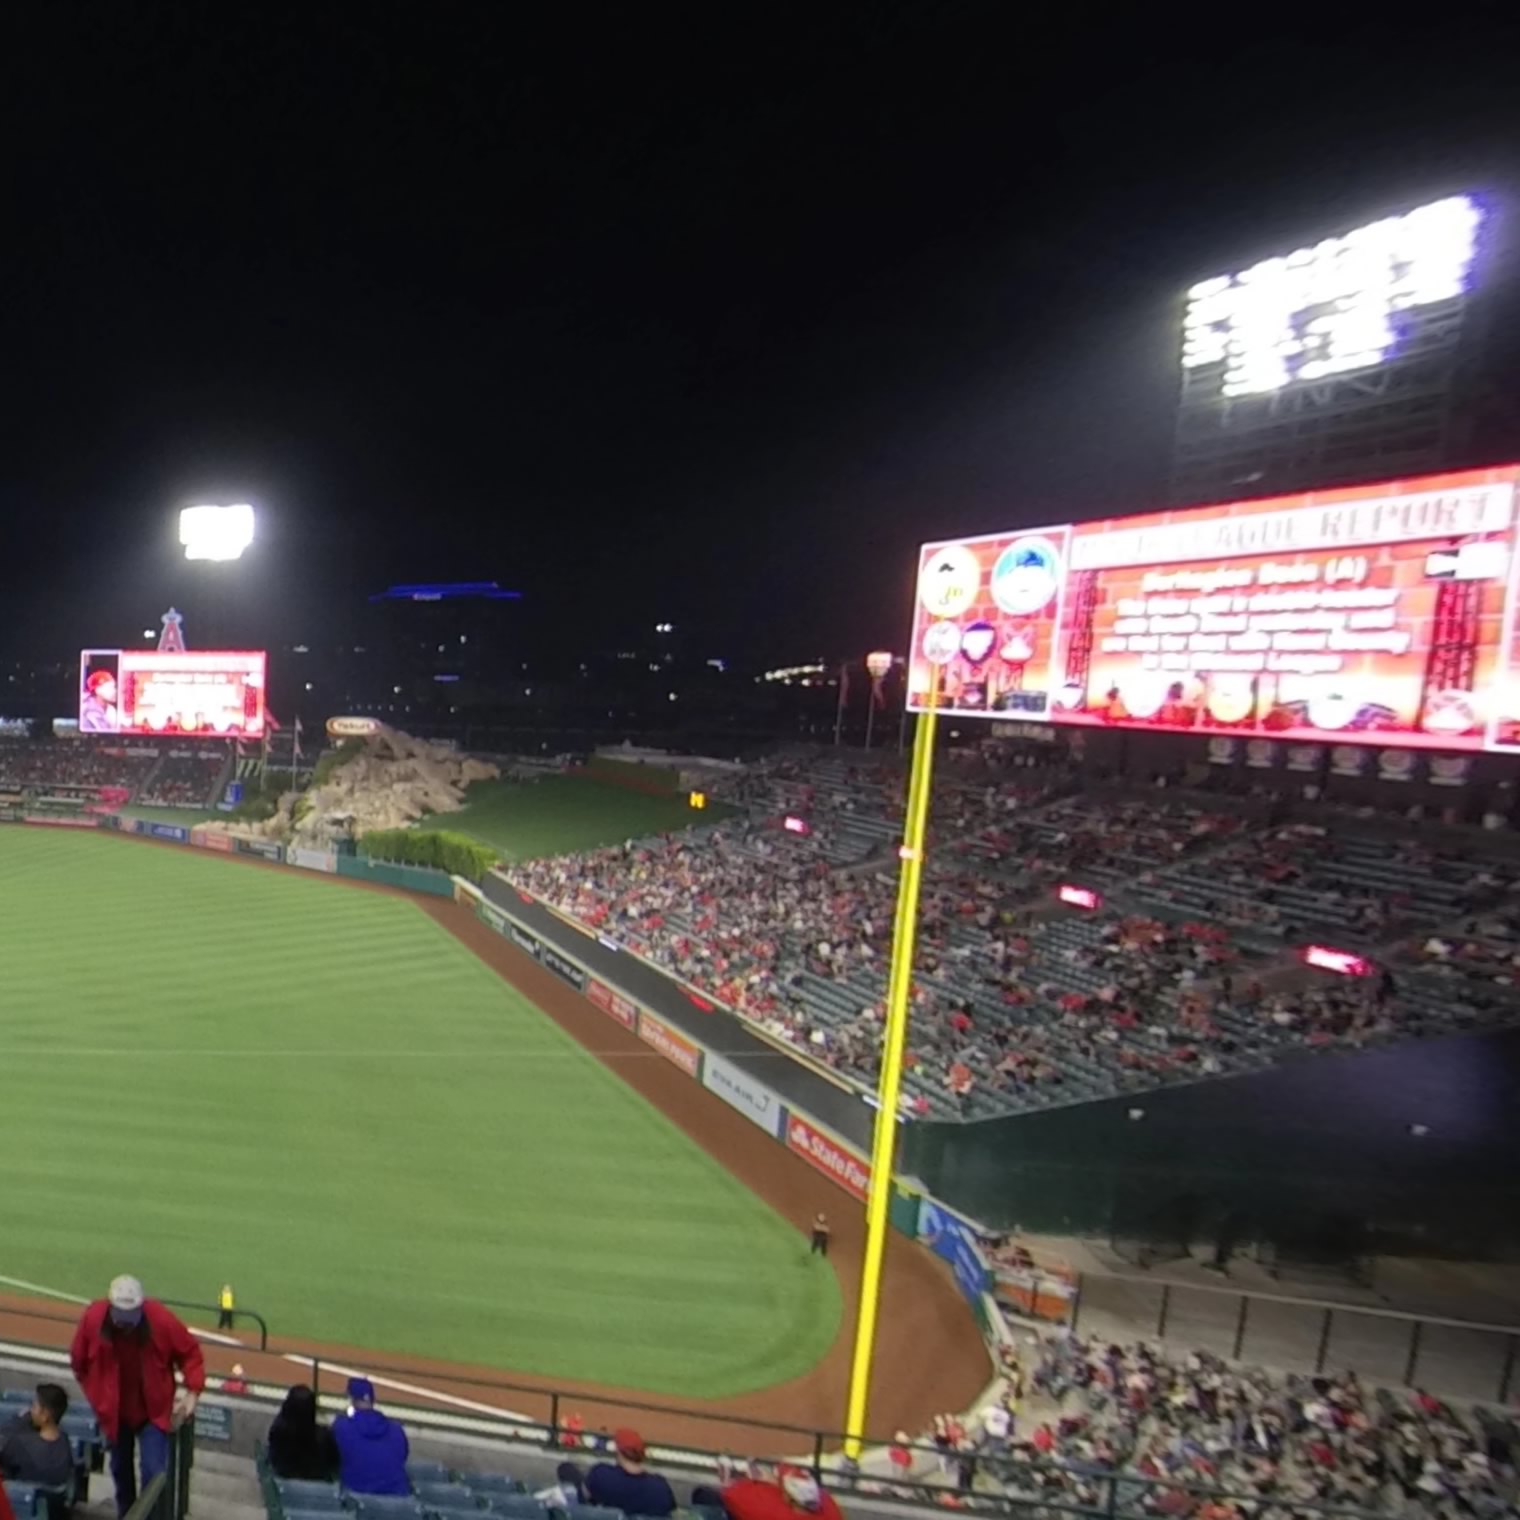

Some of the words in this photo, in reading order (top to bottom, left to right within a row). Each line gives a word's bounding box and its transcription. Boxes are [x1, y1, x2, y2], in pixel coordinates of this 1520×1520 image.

[1320, 491, 1494, 540] REPORT
[810, 1135, 846, 1176] State
[844, 1160, 871, 1191] Far
